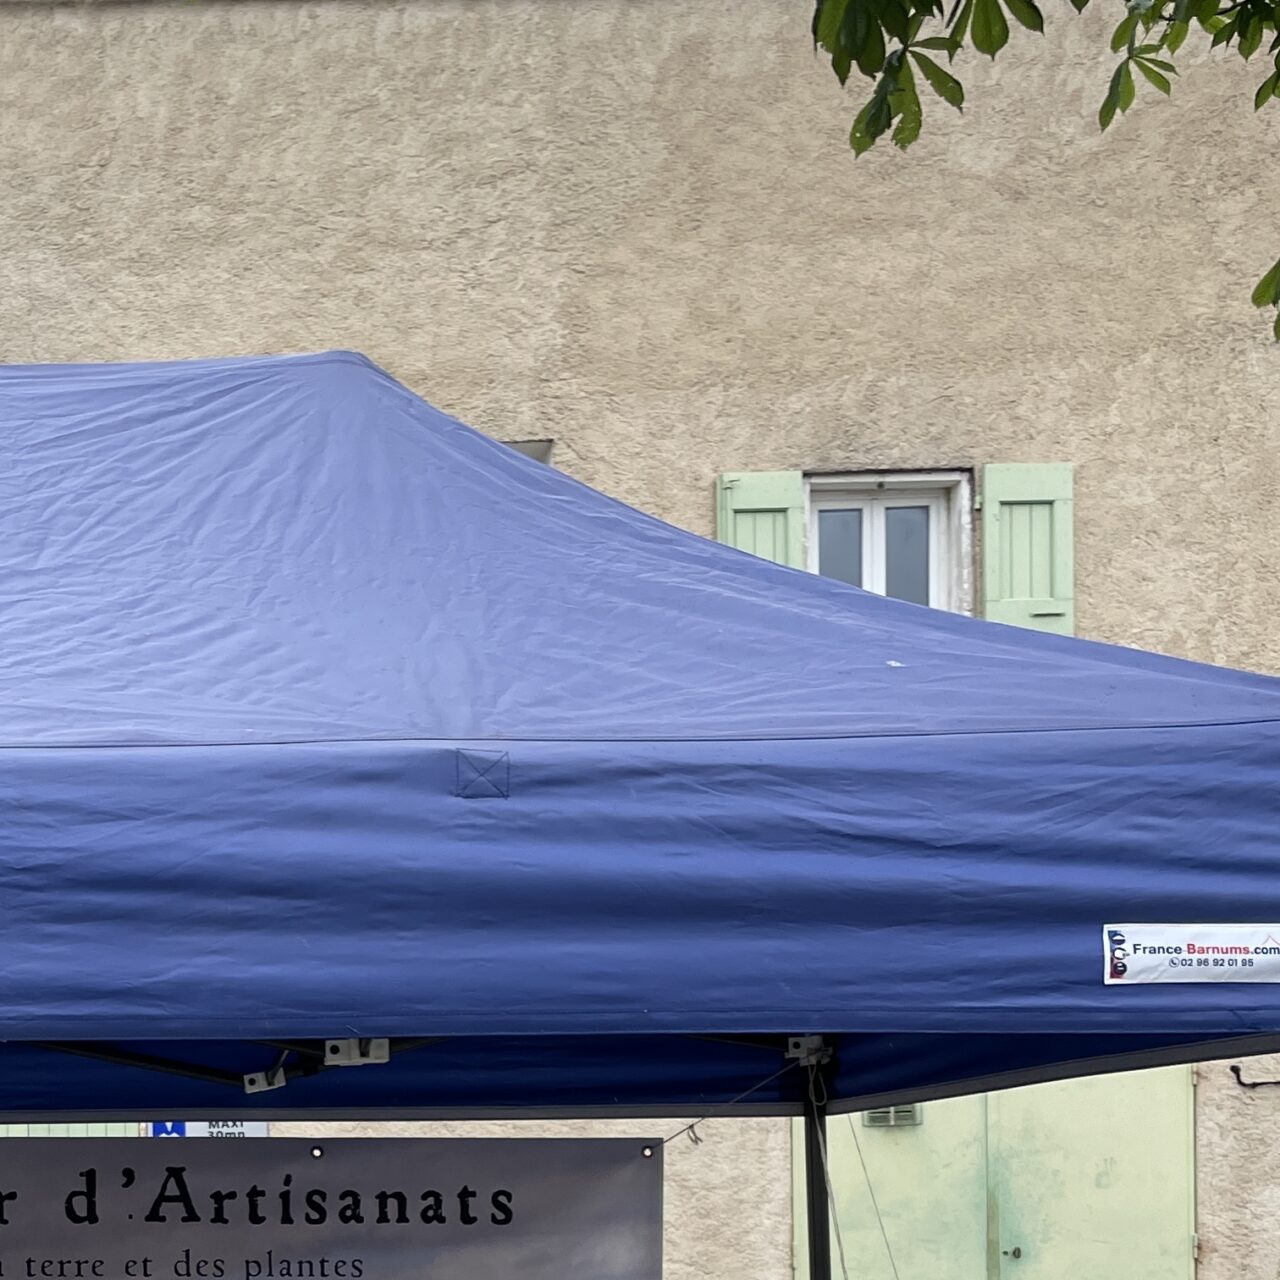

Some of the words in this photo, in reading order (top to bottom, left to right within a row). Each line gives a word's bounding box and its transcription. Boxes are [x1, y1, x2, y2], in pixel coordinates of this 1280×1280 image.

[1132, 944, 1182, 955] France
[1181, 959, 1193, 967] 02
[1196, 959, 1209, 967] 96
[1212, 959, 1225, 967] 92
[1227, 959, 1238, 967] 01
[1241, 959, 1254, 967] 95
[64, 1166, 515, 1226] d'Artisanats
[25, 1256, 105, 1279] terre
[124, 1256, 153, 1279] et
[173, 1248, 226, 1279] des
